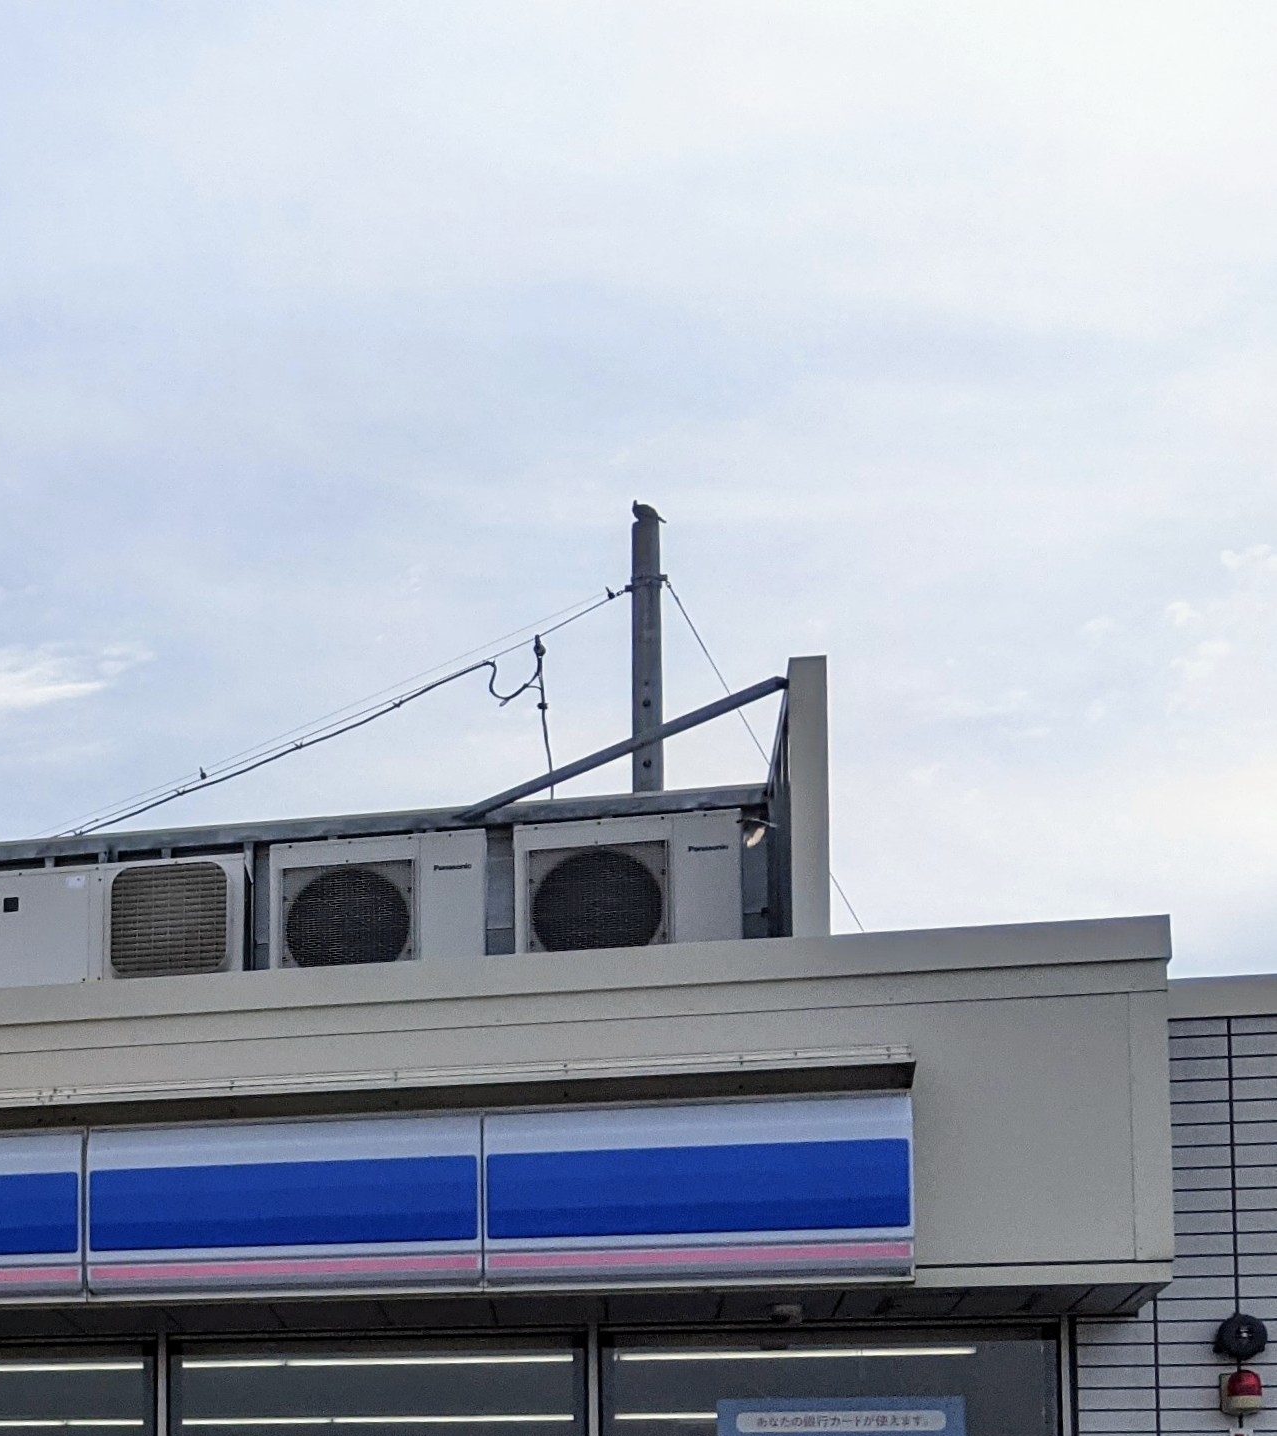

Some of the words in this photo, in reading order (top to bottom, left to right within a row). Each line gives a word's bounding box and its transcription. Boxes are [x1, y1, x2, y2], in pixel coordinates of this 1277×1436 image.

[688, 844, 729, 852] Panasonic
[433, 862, 472, 871] Panasonic
[756, 1415, 929, 1428] あなたの銀行カードが使えます。
